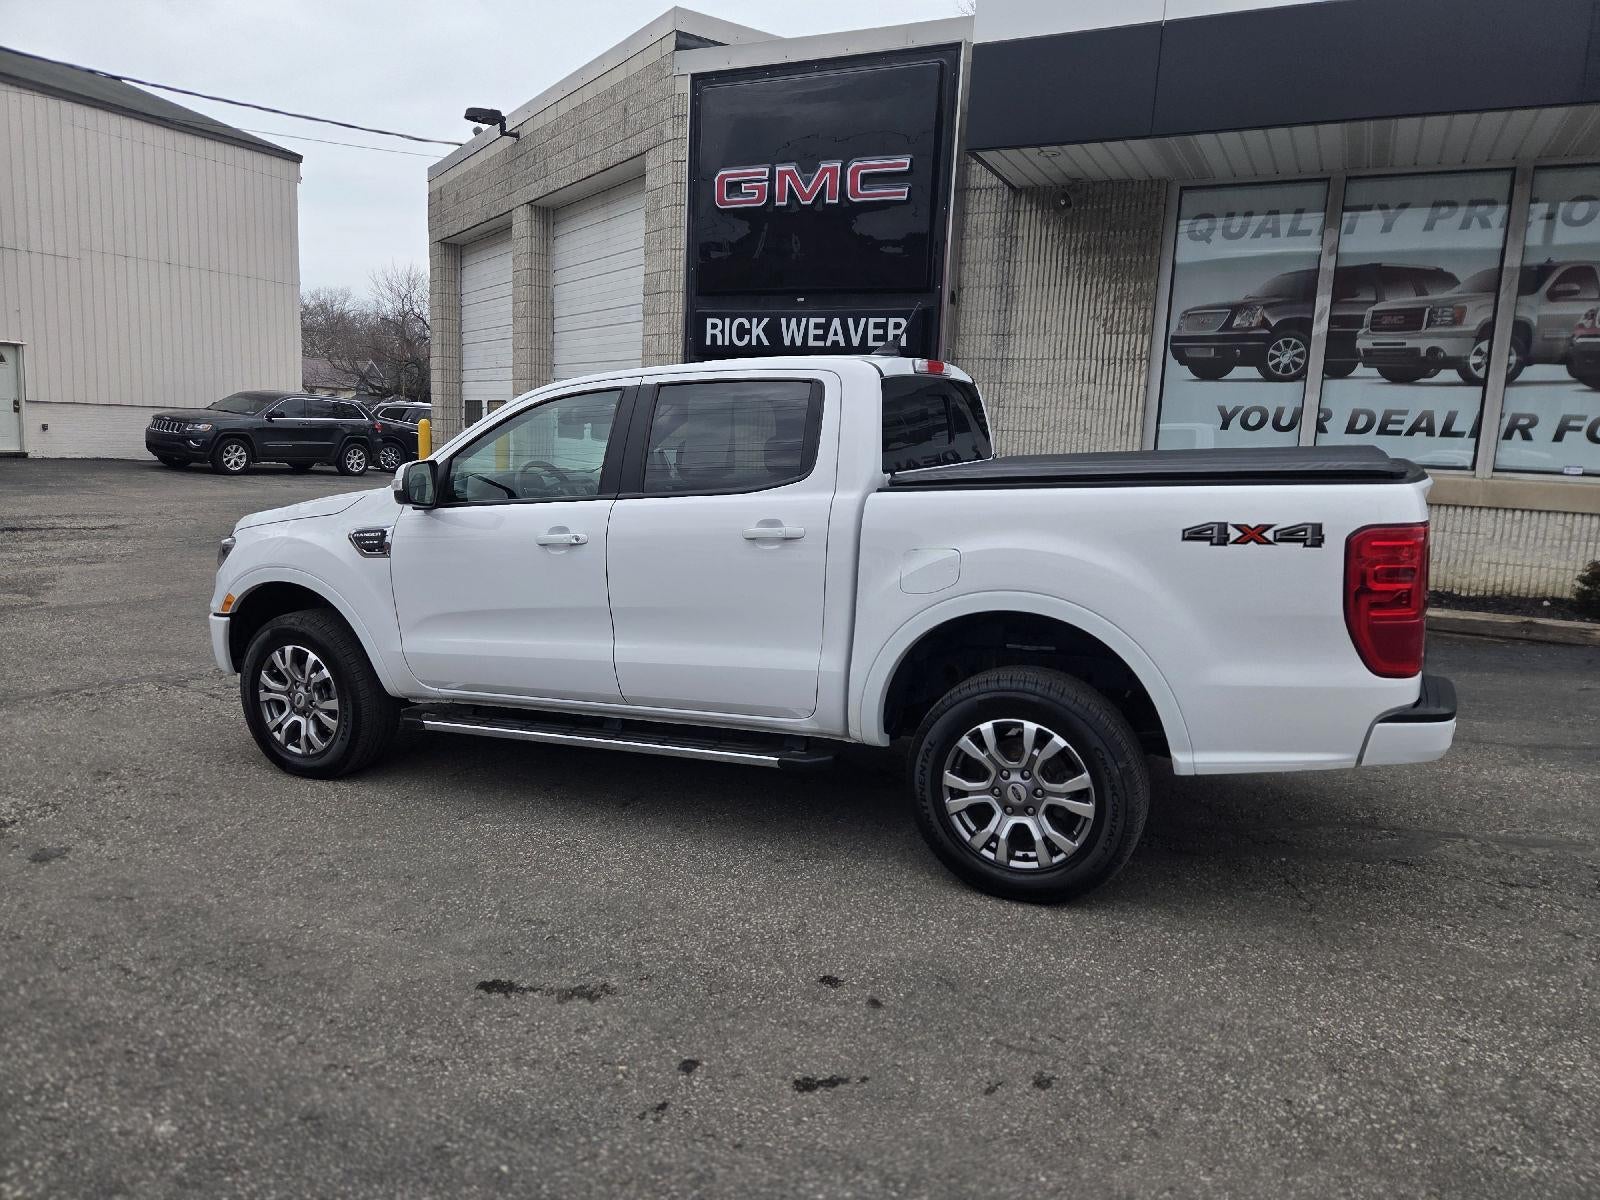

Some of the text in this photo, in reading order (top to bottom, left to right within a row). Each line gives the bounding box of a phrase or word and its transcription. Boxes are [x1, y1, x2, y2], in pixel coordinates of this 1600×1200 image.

[715, 157, 911, 209] GMC
[1187, 203, 1411, 245] QUALTY
[705, 317, 907, 348] RICK WEAVER
